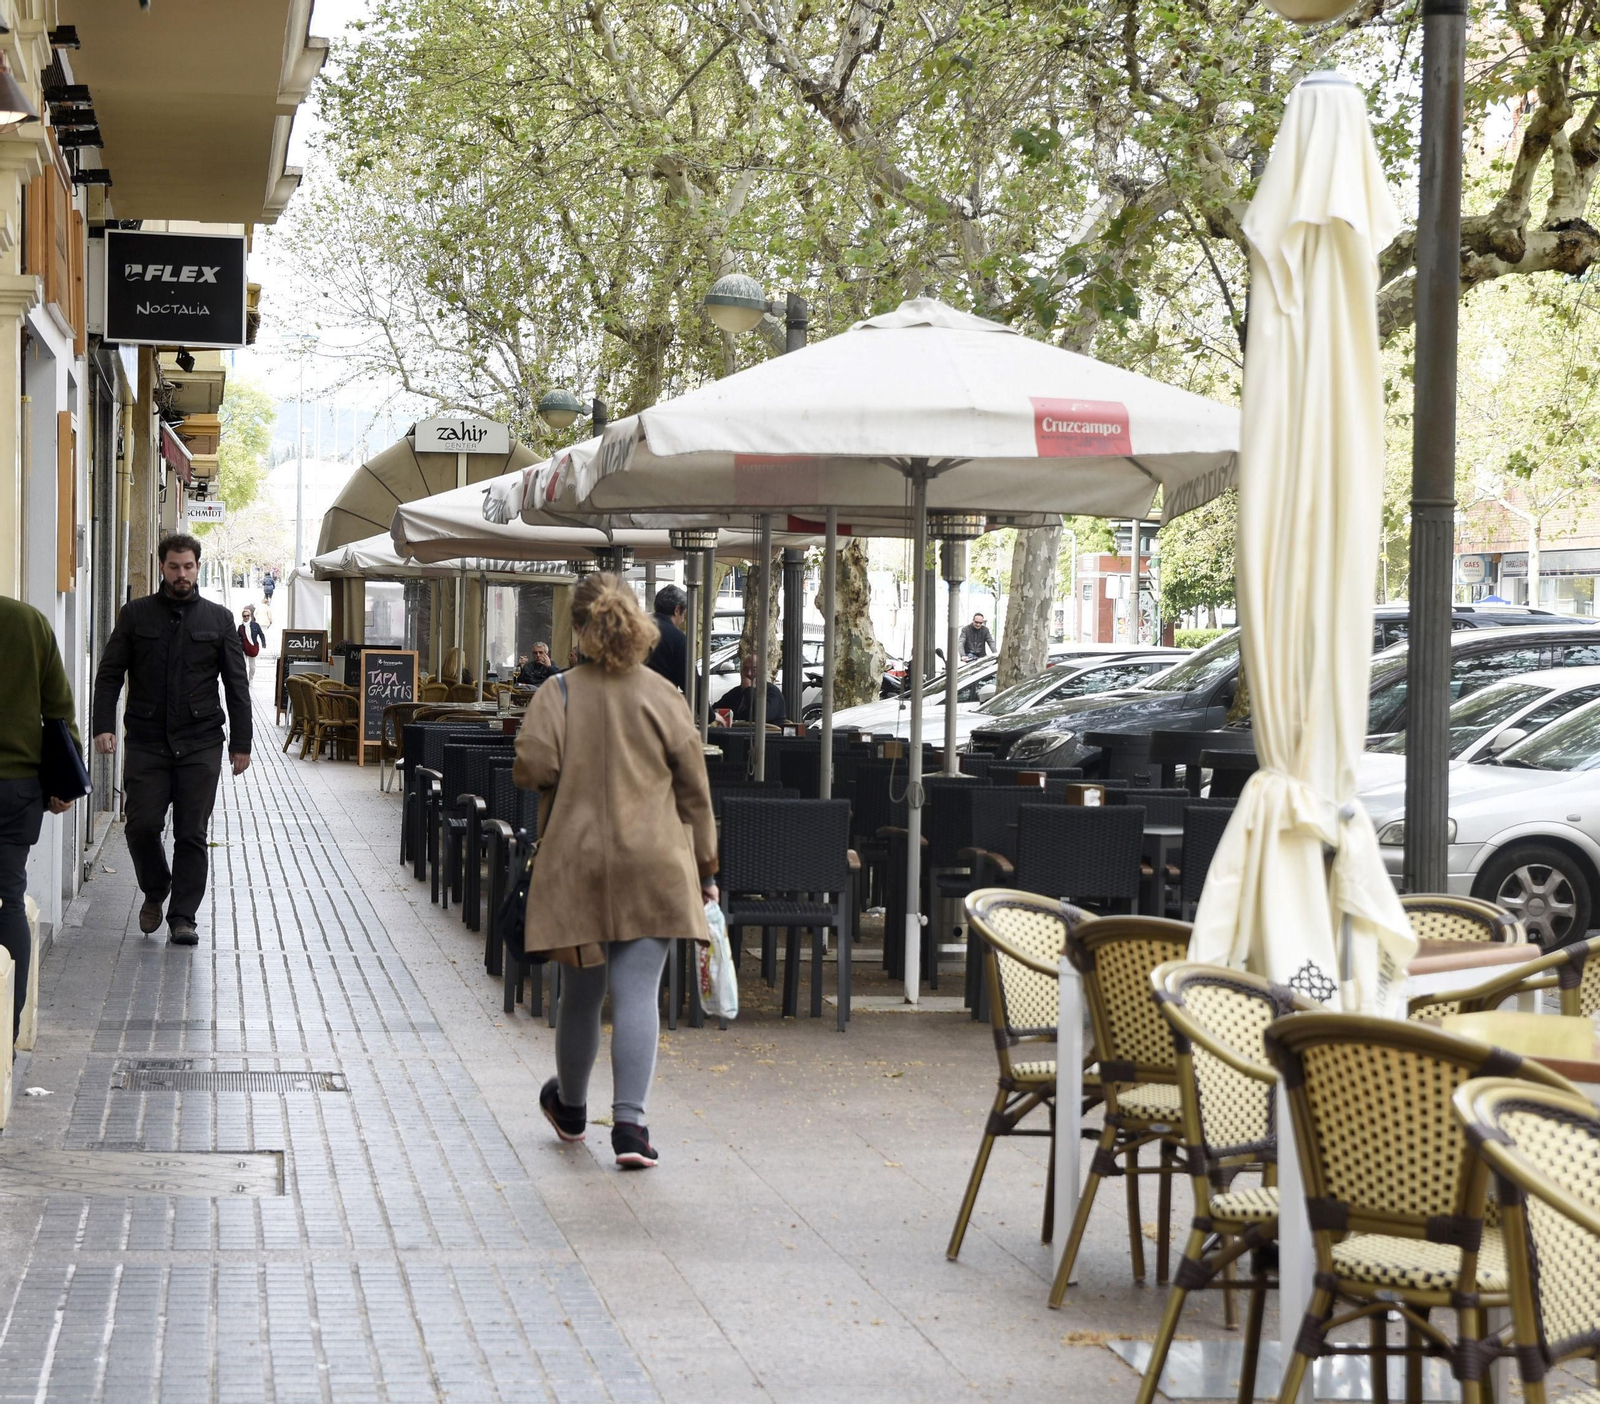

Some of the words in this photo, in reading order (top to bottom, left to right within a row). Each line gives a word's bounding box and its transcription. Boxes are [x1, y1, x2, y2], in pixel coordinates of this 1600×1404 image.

[144, 264, 221, 283] FLEX
[436, 421, 488, 443] zahir
[1041, 416, 1121, 436] Cruzcampo
[288, 636, 319, 650] zahir
[367, 669, 399, 685] TAPA
